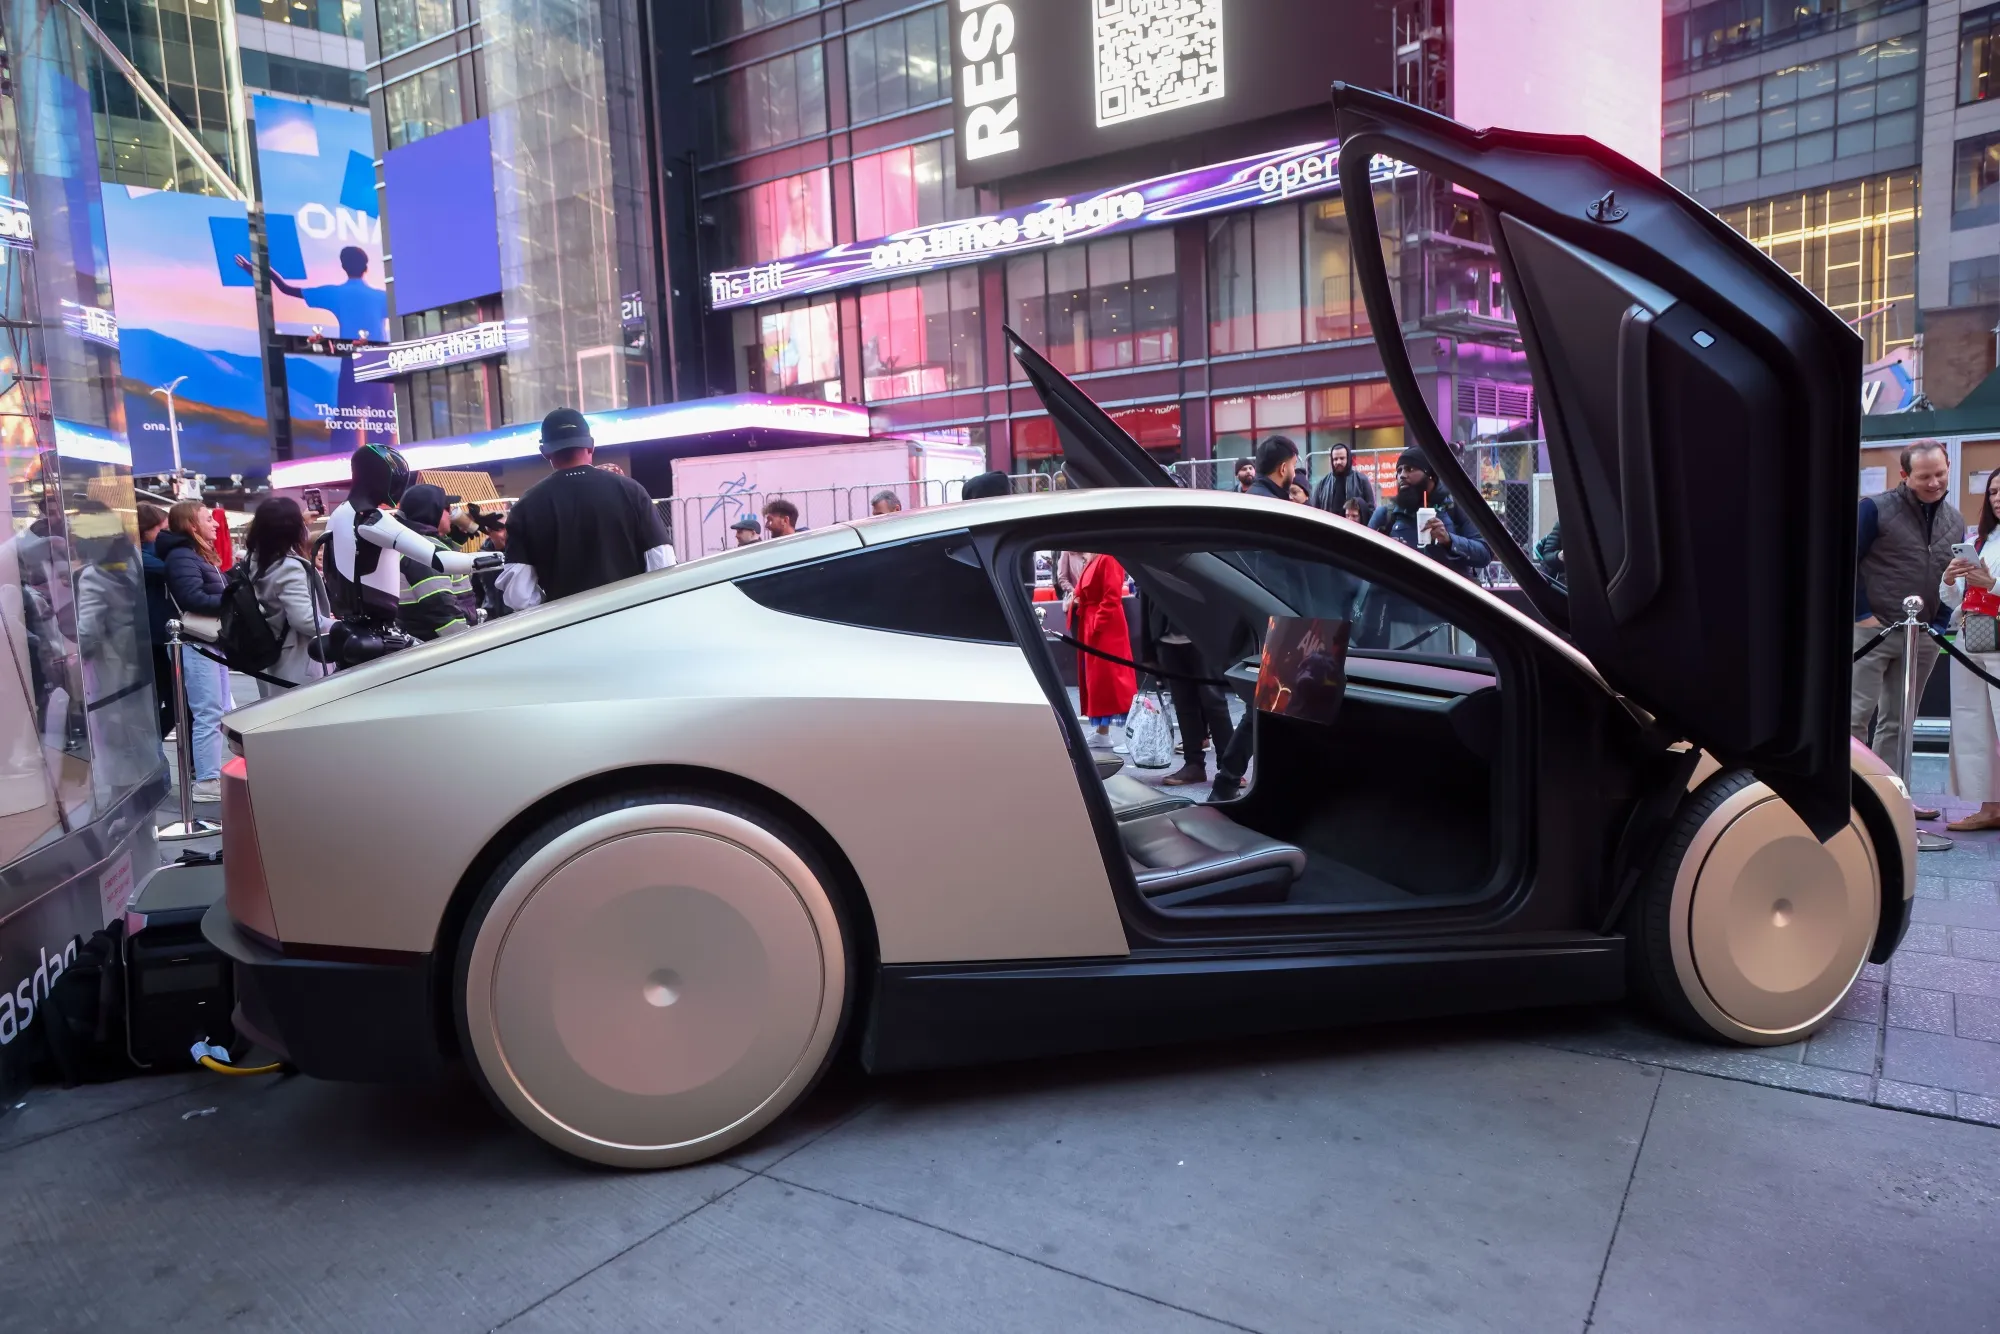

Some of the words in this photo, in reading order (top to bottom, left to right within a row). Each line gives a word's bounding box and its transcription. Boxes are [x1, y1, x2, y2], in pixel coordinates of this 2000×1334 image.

[959, 0, 1020, 161] RES
[749, 262, 784, 295] fall
[871, 237, 926, 269] one
[928, 217, 1019, 258] times
[1022, 191, 1144, 244] square
[387, 340, 445, 373] opening
[448, 328, 475, 356] this
[478, 320, 506, 350] fall
[142, 421, 184, 432] ona.i
[315, 403, 339, 417] The
[340, 404, 384, 418] mission
[325, 416, 342, 430] for
[343, 417, 380, 434] coding
